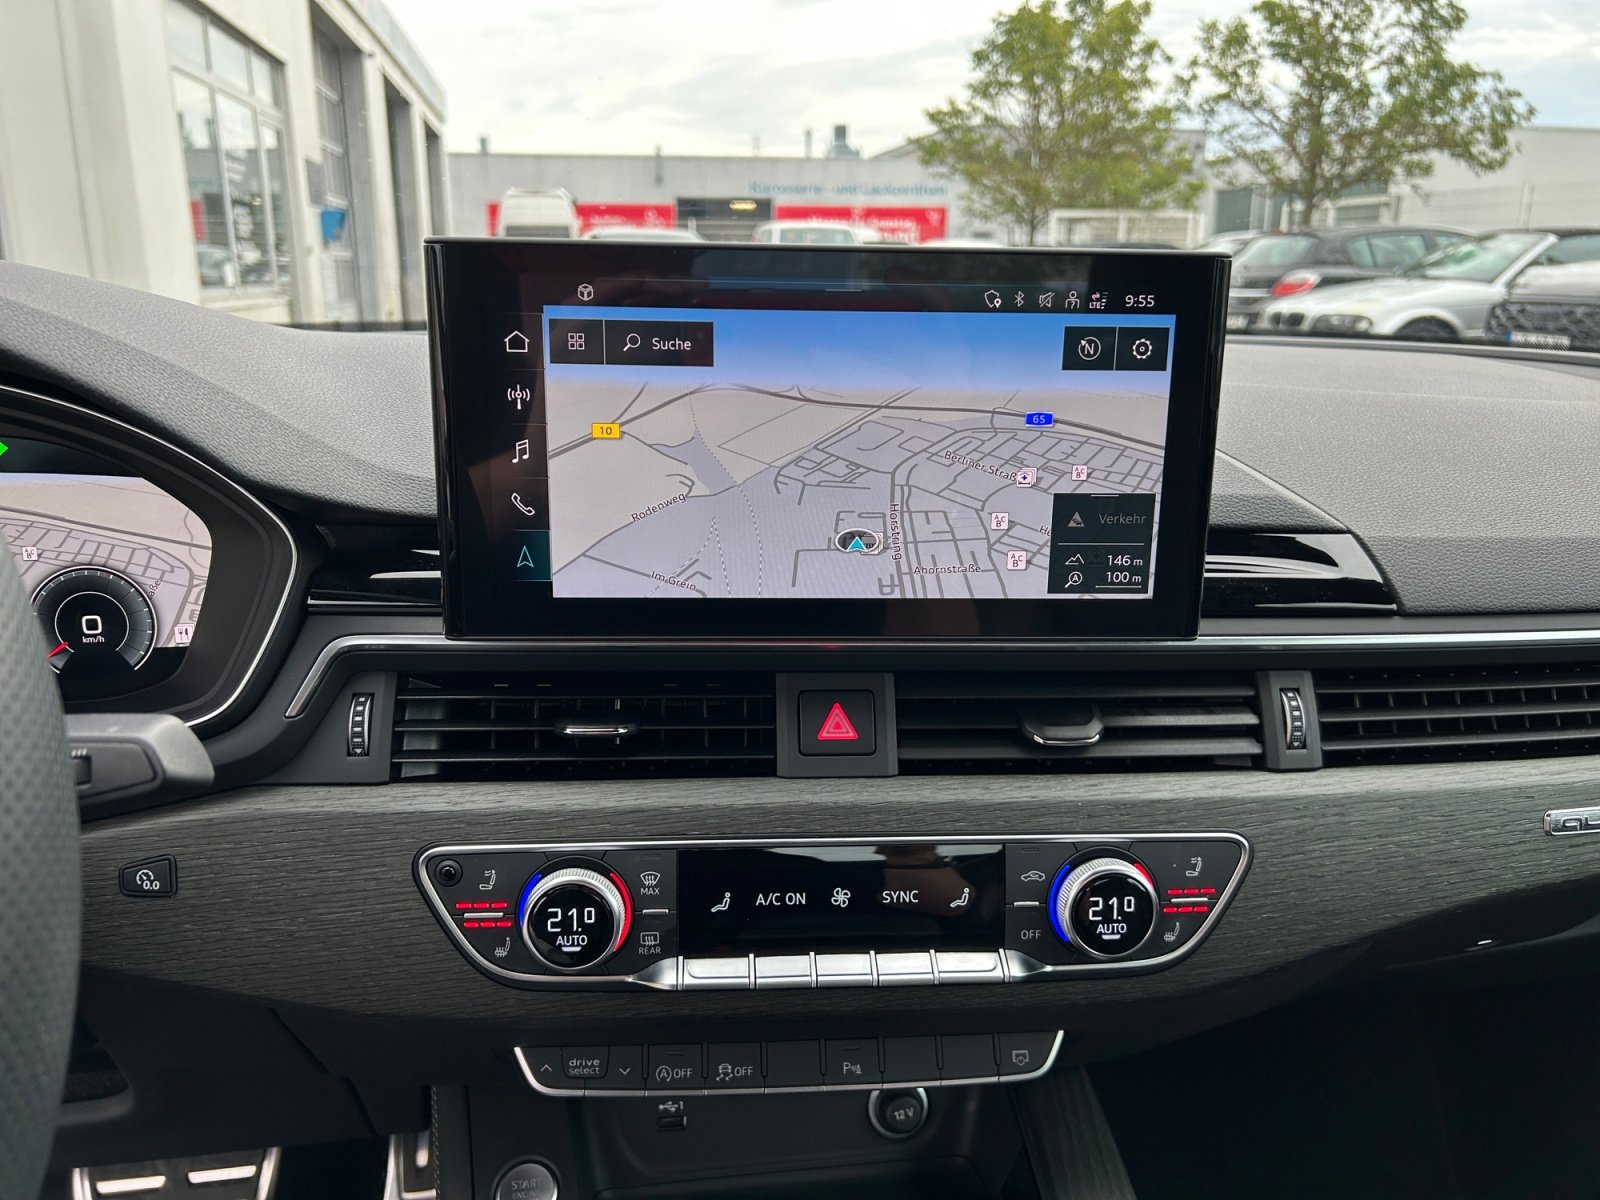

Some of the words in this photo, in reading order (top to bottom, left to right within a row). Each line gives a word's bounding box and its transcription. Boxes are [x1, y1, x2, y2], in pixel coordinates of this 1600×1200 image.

[1125, 294, 1155, 308] 9:55
[652, 337, 692, 350] Suche
[1032, 415, 1046, 424] 65
[599, 427, 612, 435] 10
[944, 450, 986, 471] Berliner
[988, 464, 1017, 482] Straß
[631, 493, 687, 522] Rodenweg
[1098, 513, 1147, 524] Verkehr
[889, 503, 903, 561] Horstring
[1107, 555, 1131, 566] 146
[914, 564, 981, 575] Ahornstraße
[651, 570, 666, 581] Im
[668, 576, 697, 591] Grein
[1106, 571, 1130, 583] 100
[82, 615, 102, 634] 0
[82, 635, 104, 644] km/h
[143, 880, 160, 890] 0.0
[640, 887, 660, 895] MAX
[882, 890, 919, 903] SYNC
[756, 893, 781, 905] A/C
[786, 893, 806, 905] ON
[1096, 923, 1127, 934] AUTO
[556, 935, 588, 946] AUTO
[1020, 930, 1041, 940] OFF
[638, 946, 661, 955] REAR
[569, 1058, 600, 1066] drive
[569, 1066, 600, 1075] select
[673, 1068, 693, 1078] OFF
[734, 1066, 753, 1077] OFF
[894, 1110, 905, 1120] 12
[906, 1107, 914, 1117] V
